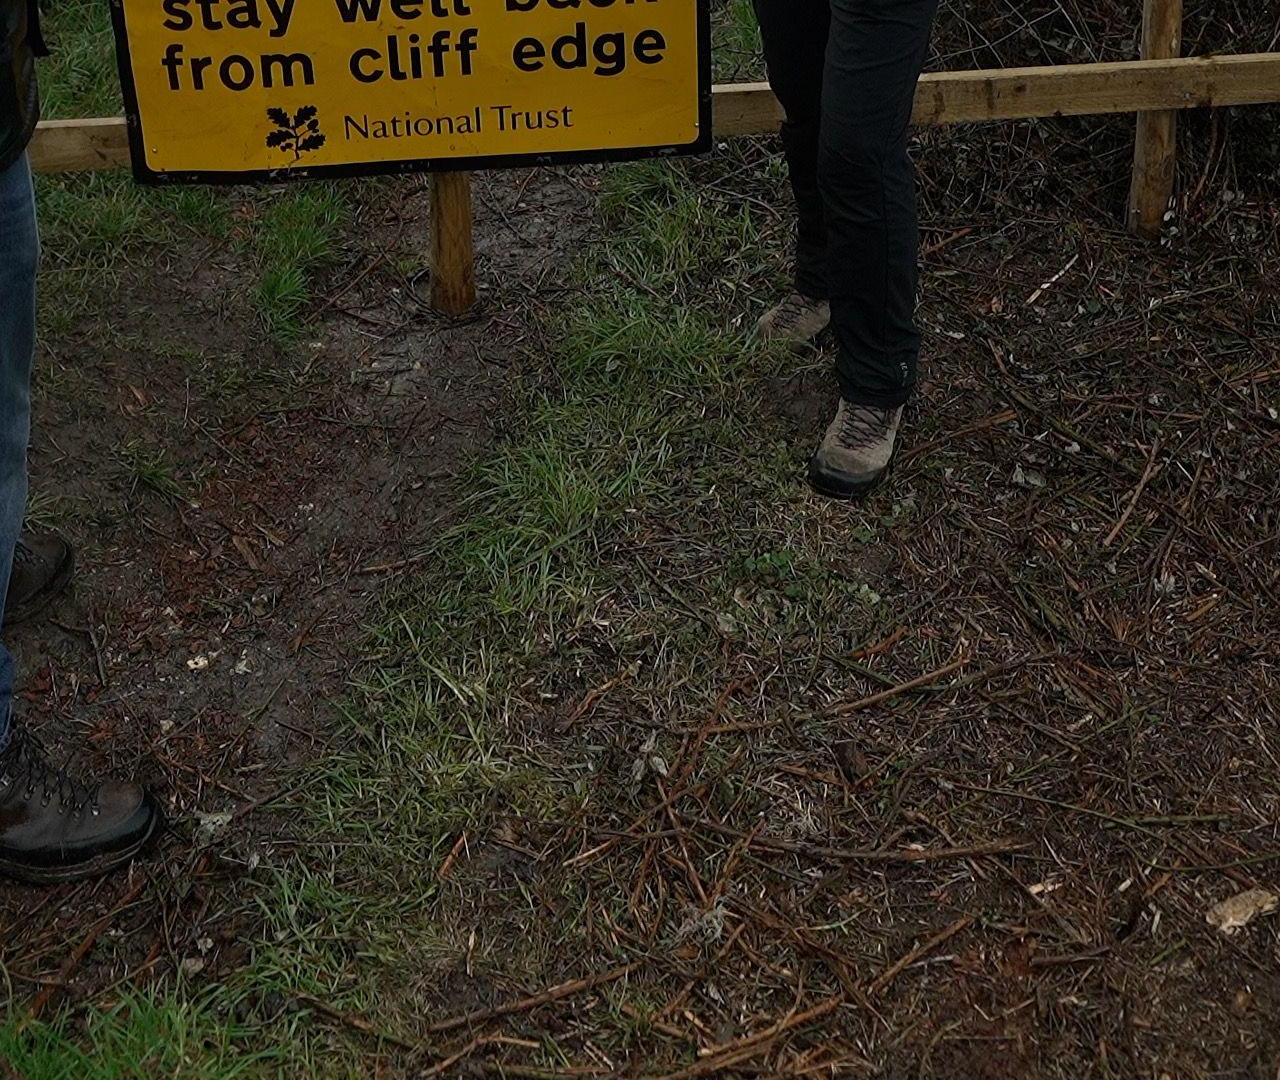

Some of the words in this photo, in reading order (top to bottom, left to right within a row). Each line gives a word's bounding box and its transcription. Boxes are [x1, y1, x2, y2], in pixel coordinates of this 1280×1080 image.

[161, 43, 315, 92] from
[349, 28, 479, 84] cliff
[512, 21, 667, 77] edge
[344, 106, 481, 141] National
[490, 105, 574, 132] Trust
